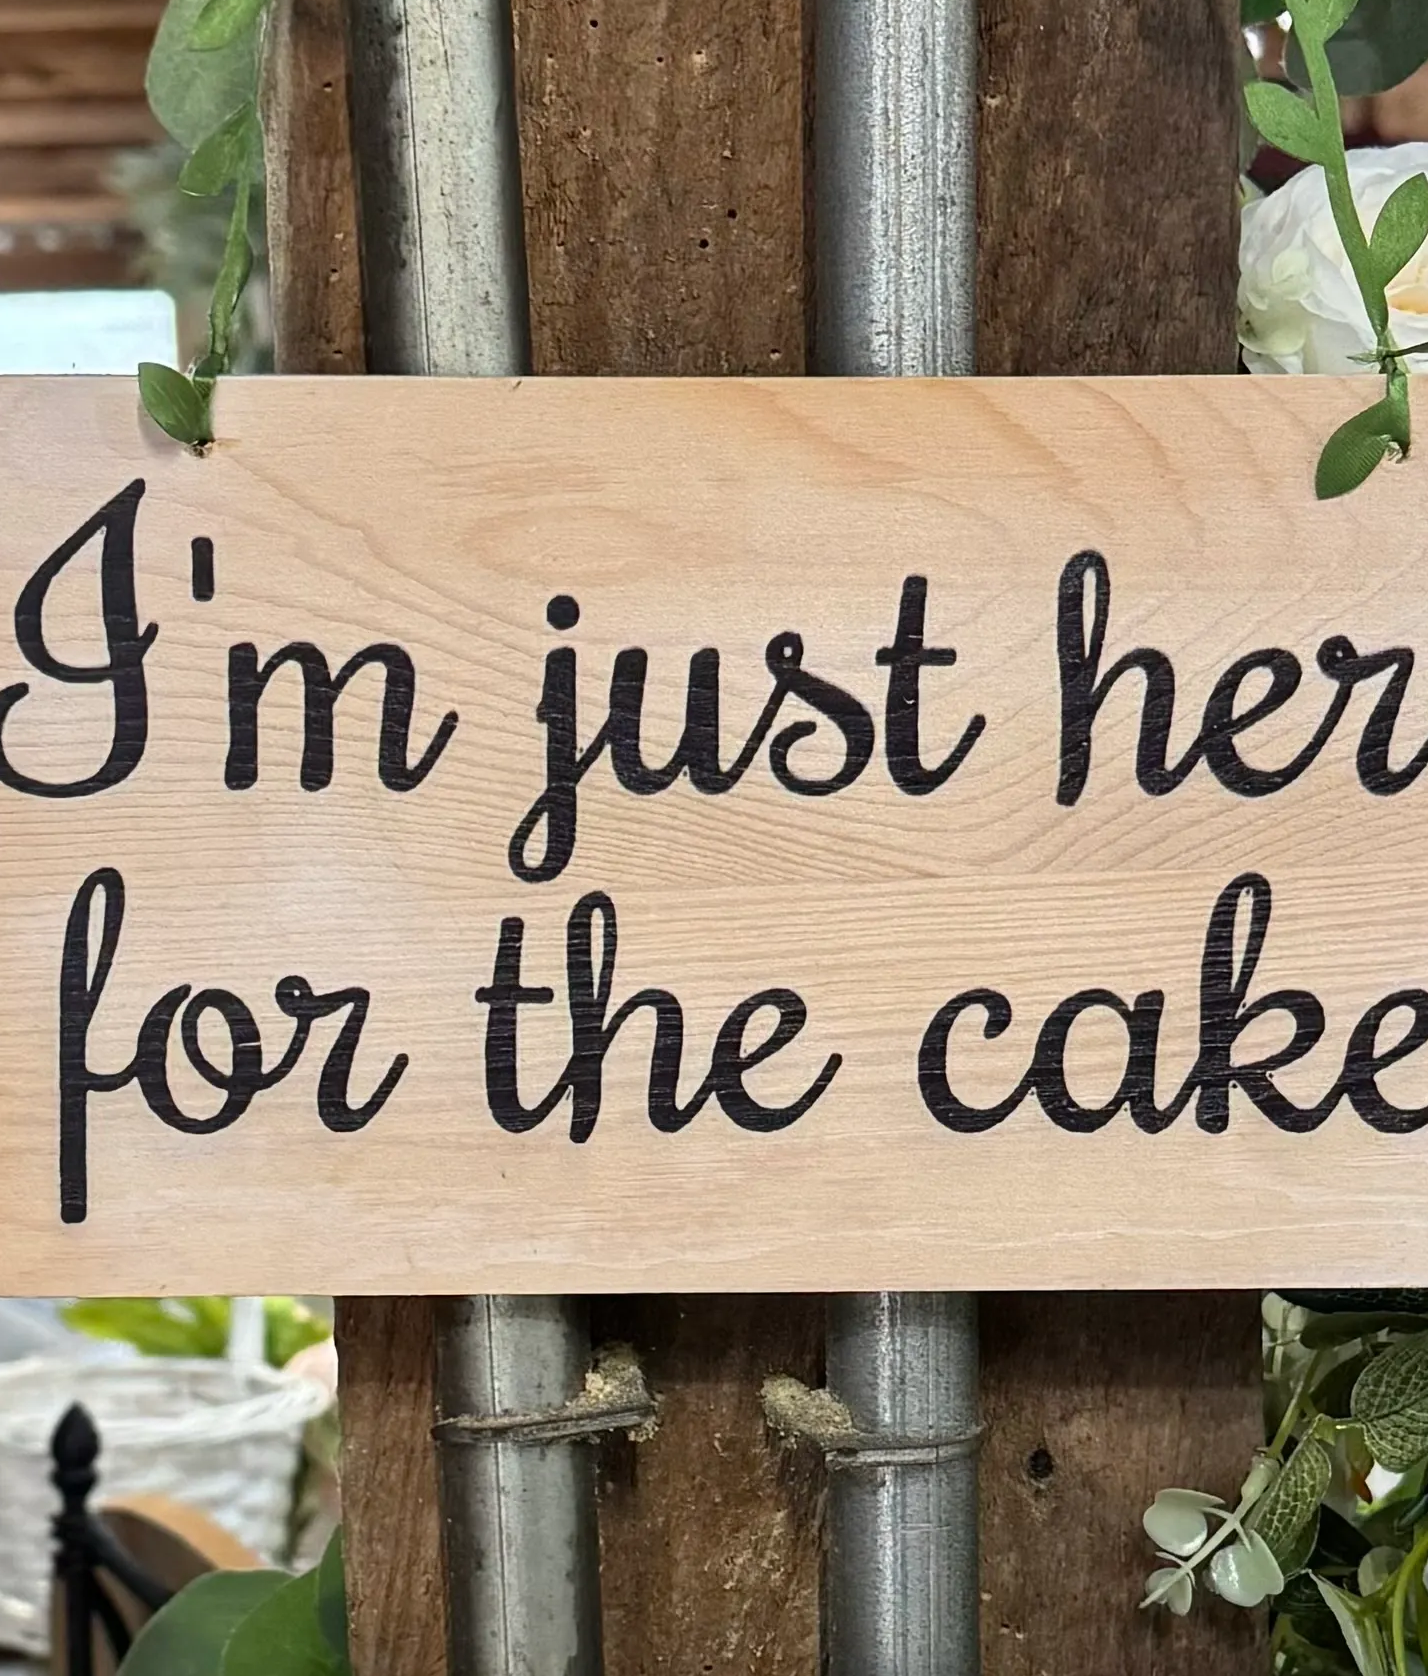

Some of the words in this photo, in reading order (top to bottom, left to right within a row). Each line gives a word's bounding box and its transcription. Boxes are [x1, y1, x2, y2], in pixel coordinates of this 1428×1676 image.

[509, 576, 986, 883] just
[60, 868, 408, 1223] for
[475, 891, 842, 1143] the
